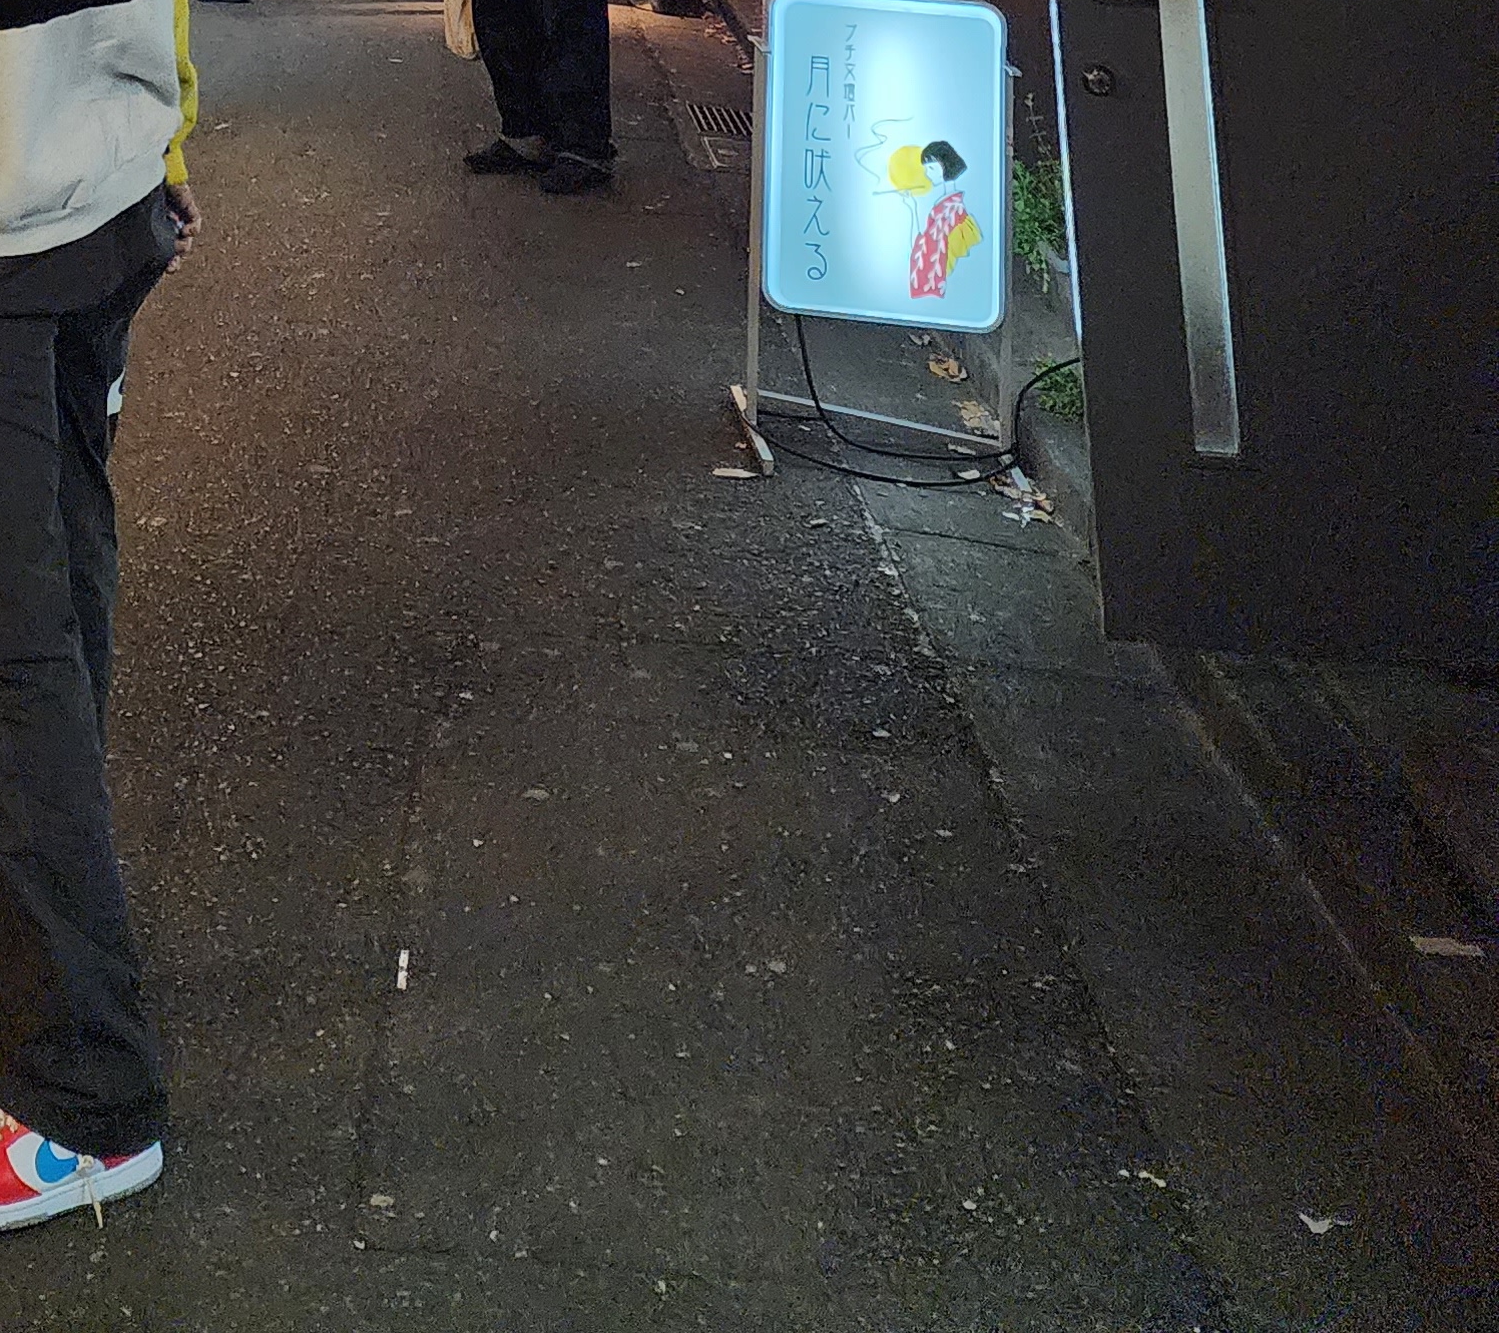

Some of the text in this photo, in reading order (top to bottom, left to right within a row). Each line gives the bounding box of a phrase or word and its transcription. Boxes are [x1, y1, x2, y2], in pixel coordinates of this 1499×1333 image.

[803, 54, 832, 281] 月に吠える
